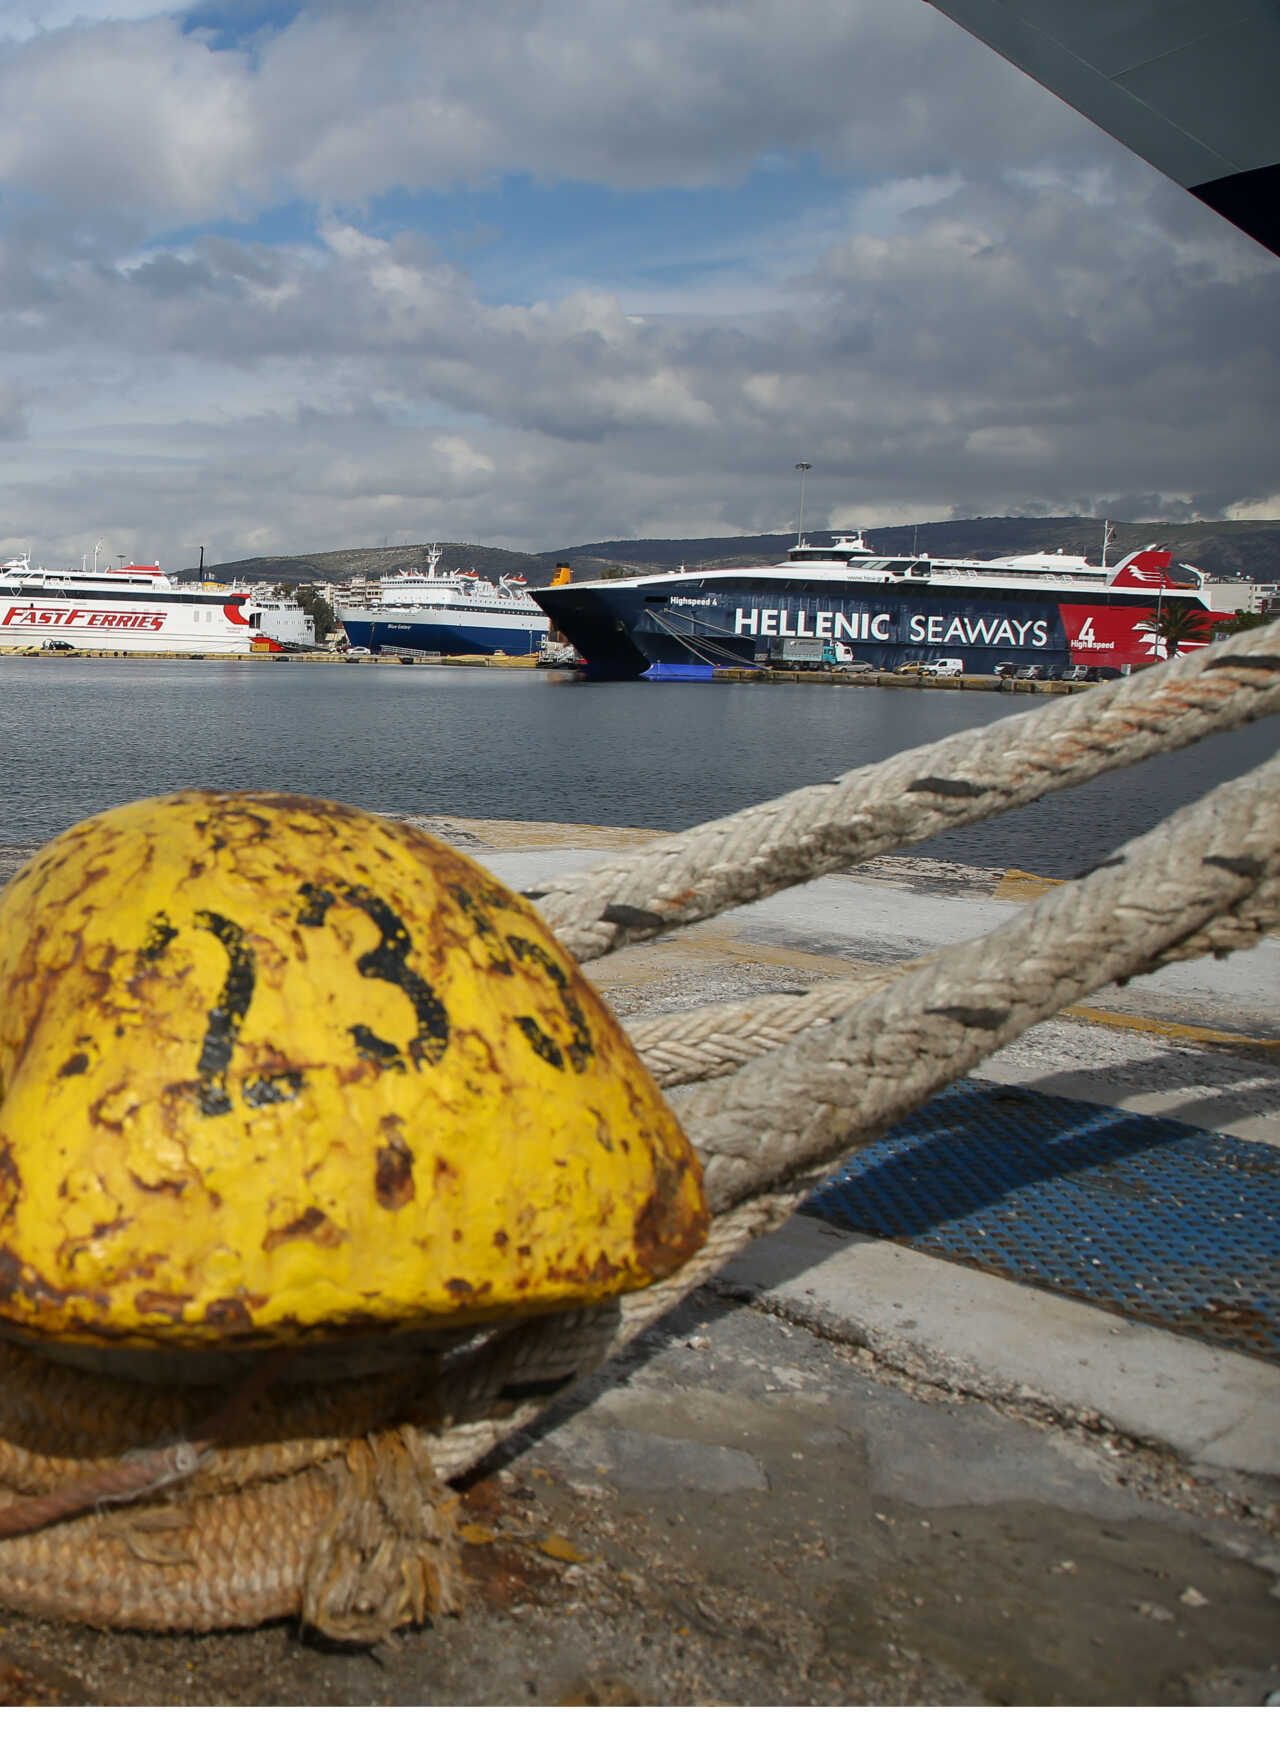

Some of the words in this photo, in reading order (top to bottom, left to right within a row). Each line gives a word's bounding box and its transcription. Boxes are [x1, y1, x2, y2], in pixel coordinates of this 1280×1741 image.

[670, 595, 710, 608] Highspeed
[711, 597, 718, 607] 4
[735, 607, 891, 641] HELLENIC
[909, 614, 1048, 648] SEAWAYS
[1077, 617, 1096, 648] 4
